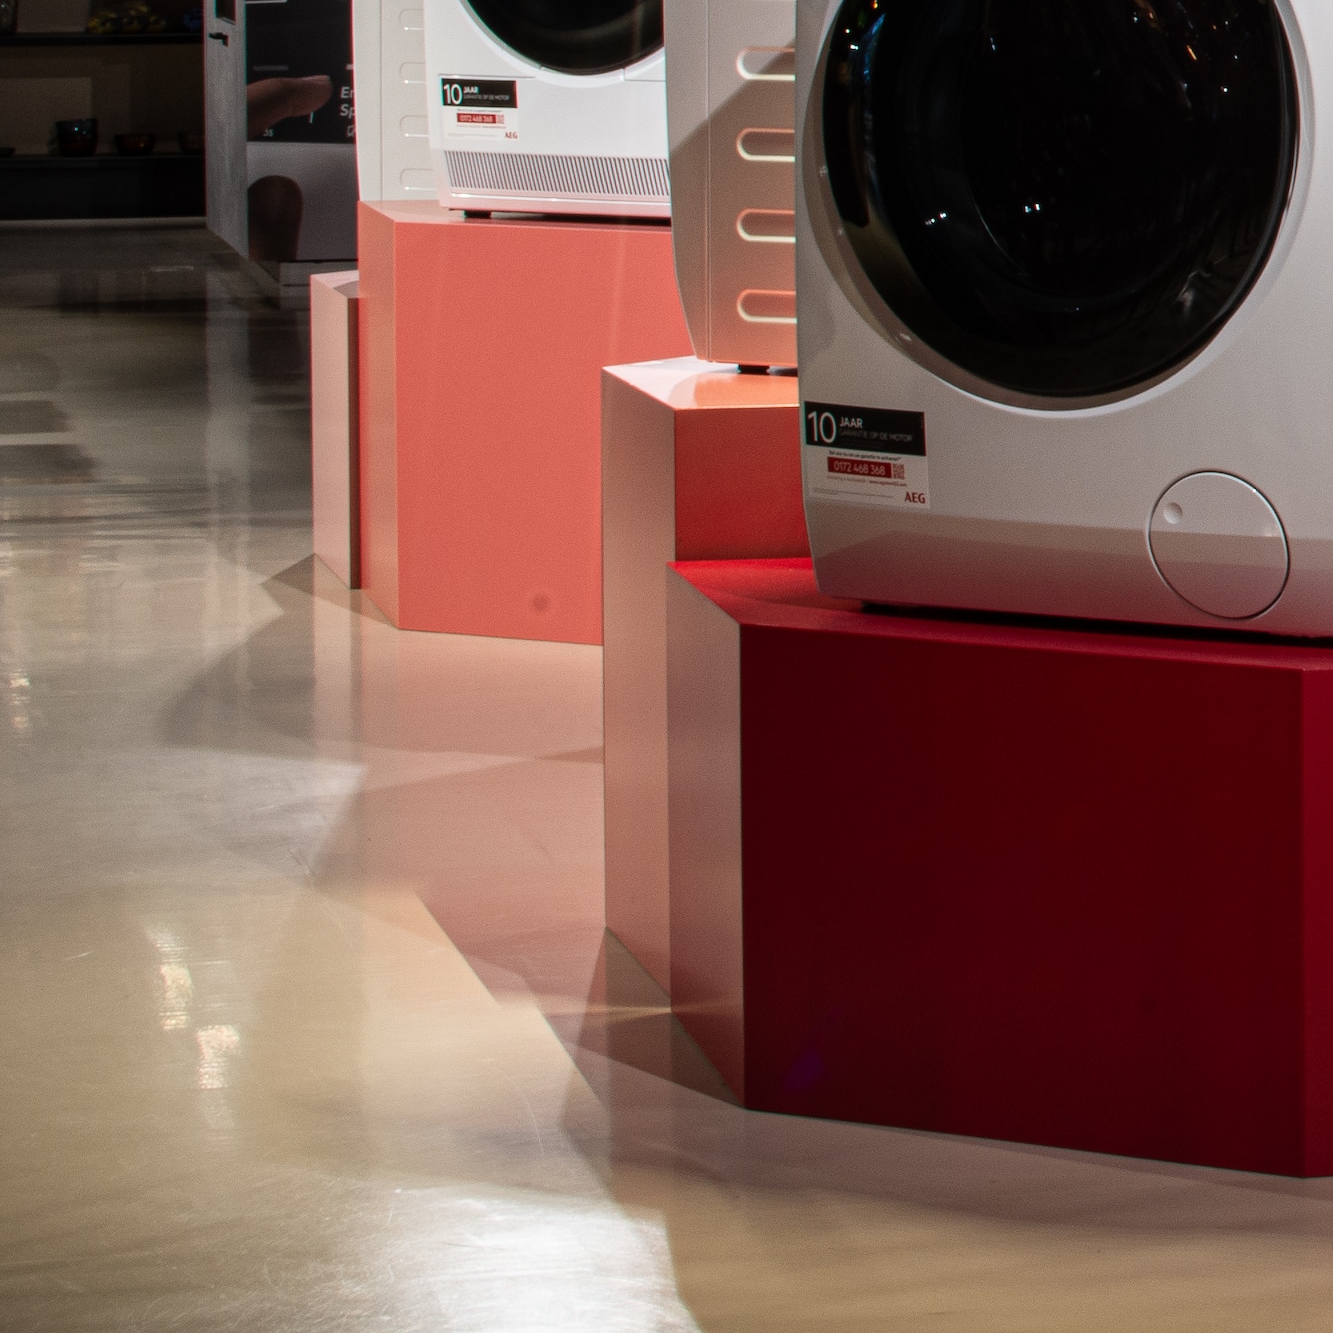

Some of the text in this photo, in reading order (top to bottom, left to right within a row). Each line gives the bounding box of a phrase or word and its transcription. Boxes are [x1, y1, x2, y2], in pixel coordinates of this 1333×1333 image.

[443, 83, 463, 105] 10
[463, 86, 480, 94] JAAR
[505, 131, 518, 139] AEG
[807, 411, 837, 444] 10
[840, 417, 863, 429] JAAR
[869, 431, 880, 439] OP
[880, 432, 888, 440] DE
[889, 433, 913, 442] MOTOR
[833, 461, 886, 476] 0172 468 368
[904, 491, 926, 504] AEG
